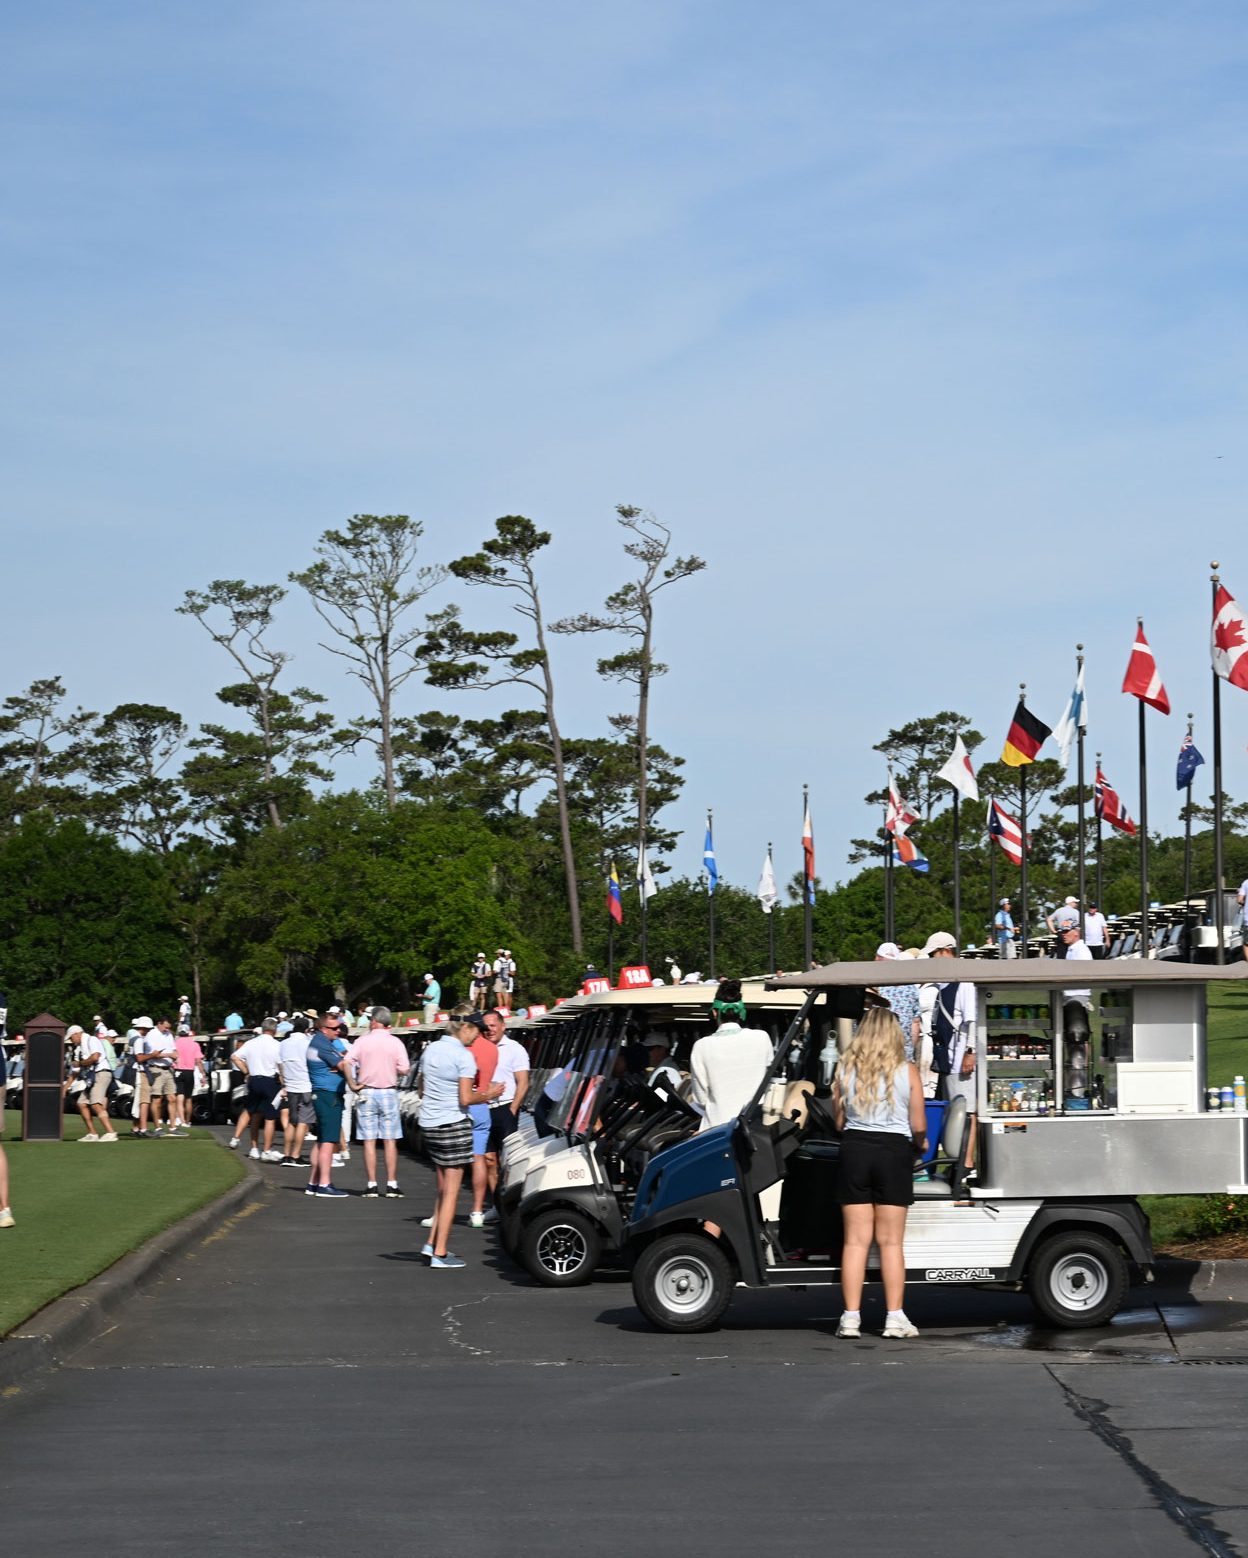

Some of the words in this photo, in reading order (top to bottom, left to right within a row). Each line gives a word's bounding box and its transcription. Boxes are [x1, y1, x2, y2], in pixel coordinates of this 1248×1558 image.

[626, 969, 650, 984] 18A
[588, 981, 610, 993] 17A
[567, 1169, 585, 1180] 080
[925, 1268, 995, 1281] CARRYALL
